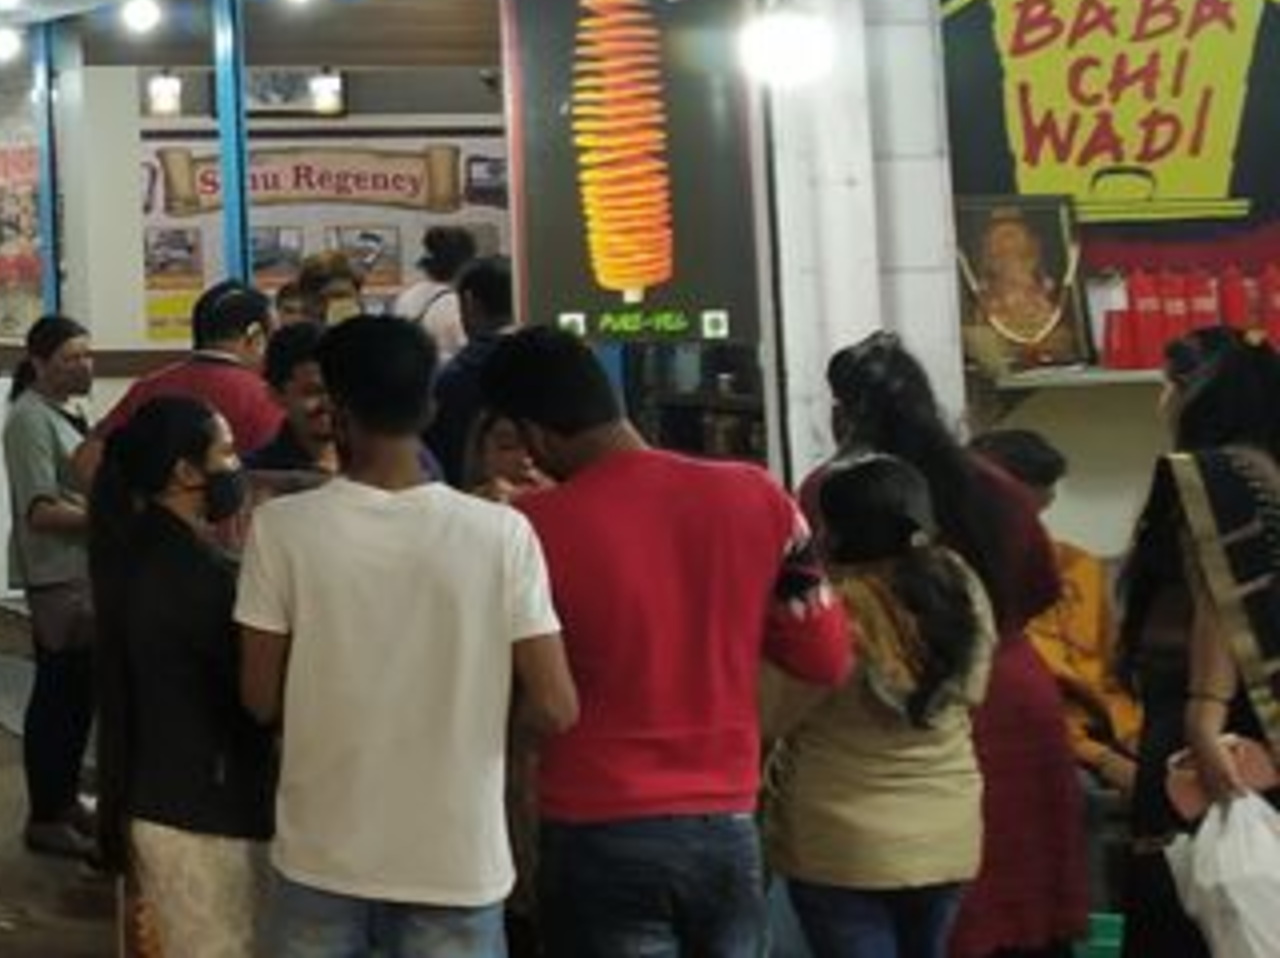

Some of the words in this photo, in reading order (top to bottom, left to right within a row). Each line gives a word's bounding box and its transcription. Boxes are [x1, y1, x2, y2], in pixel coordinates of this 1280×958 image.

[1067, 48, 1190, 108] CHI
[1019, 81, 1214, 168] WADI
[197, 168, 283, 196] Snu
[291, 165, 426, 198] Regency
